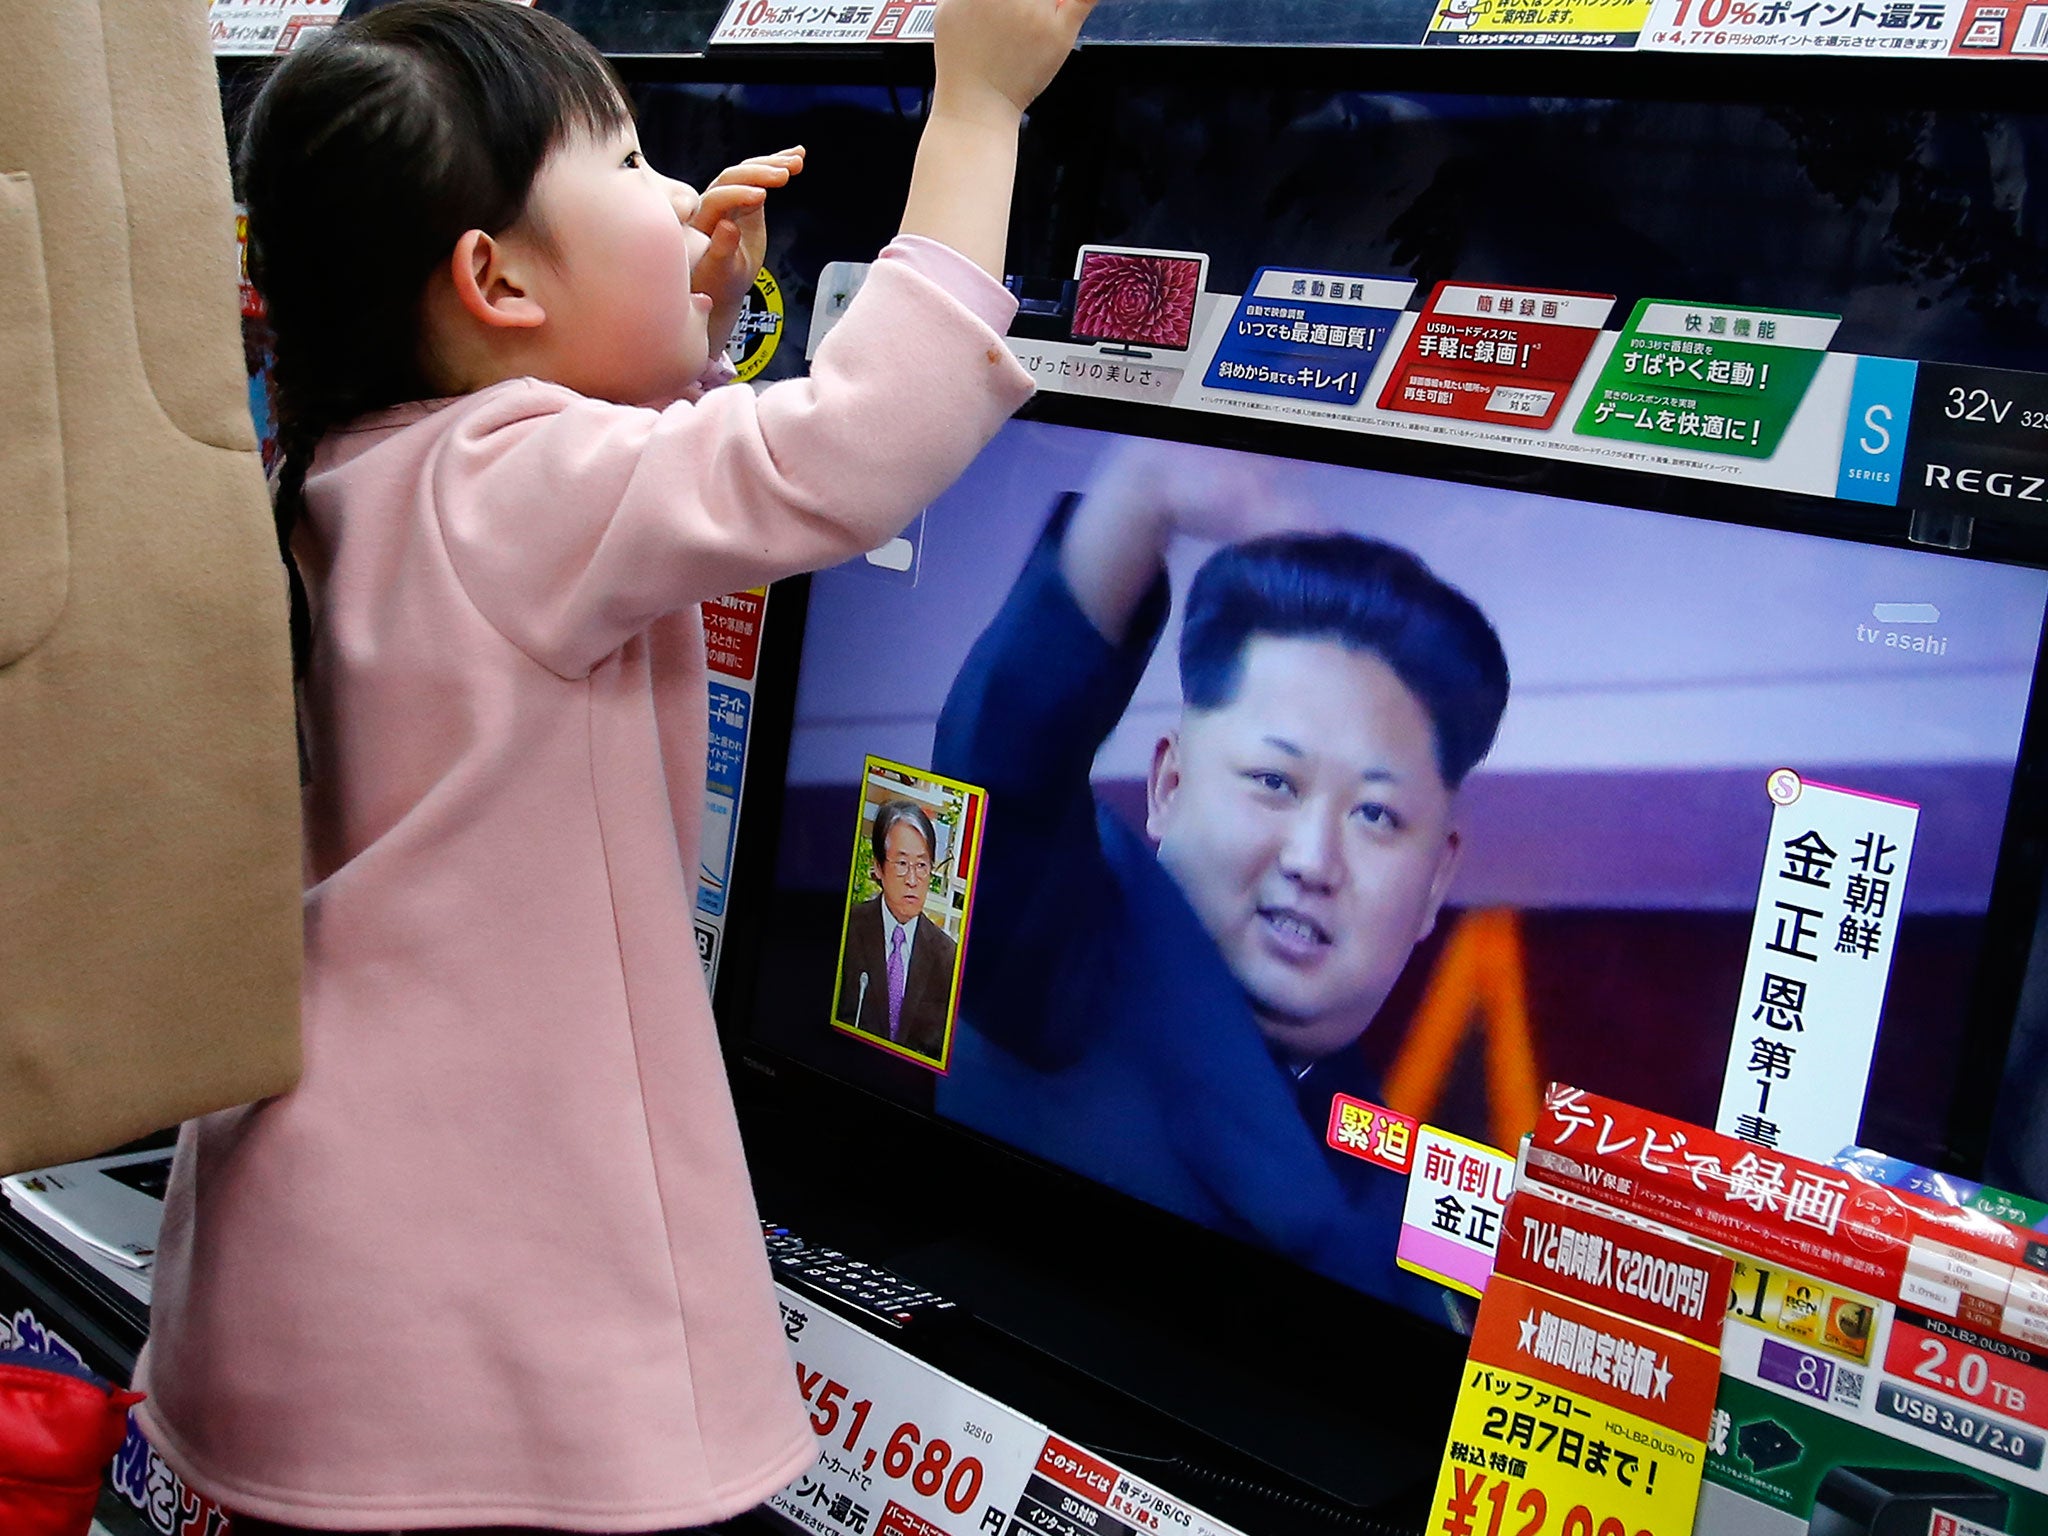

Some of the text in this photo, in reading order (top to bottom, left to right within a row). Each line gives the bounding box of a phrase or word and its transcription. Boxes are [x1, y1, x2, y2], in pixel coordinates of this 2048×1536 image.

[1291, 279, 1364, 301] 感動画質
[1426, 322, 1518, 341] USBハードディスクに
[1685, 313, 1777, 340] 快適機能
[1944, 387, 2013, 424] 32V
[1859, 404, 1893, 455] S
[1848, 468, 1891, 483] SERIES
[1924, 464, 2048, 502] REGZ
[1856, 623, 1948, 656] tv asahi
[1832, 831, 1899, 961] 北朝鮮
[1337, 1102, 1410, 1167] 緊迫
[1552, 1098, 1850, 1237] テレビで録画
[1431, 1193, 1501, 1250] 金正
[1471, 1370, 1593, 1420] バッファロー
[962, 1420, 995, 1445] 32S10
[1043, 1448, 1112, 1493] このテレビは
[786, 1474, 871, 1535] ント還元
